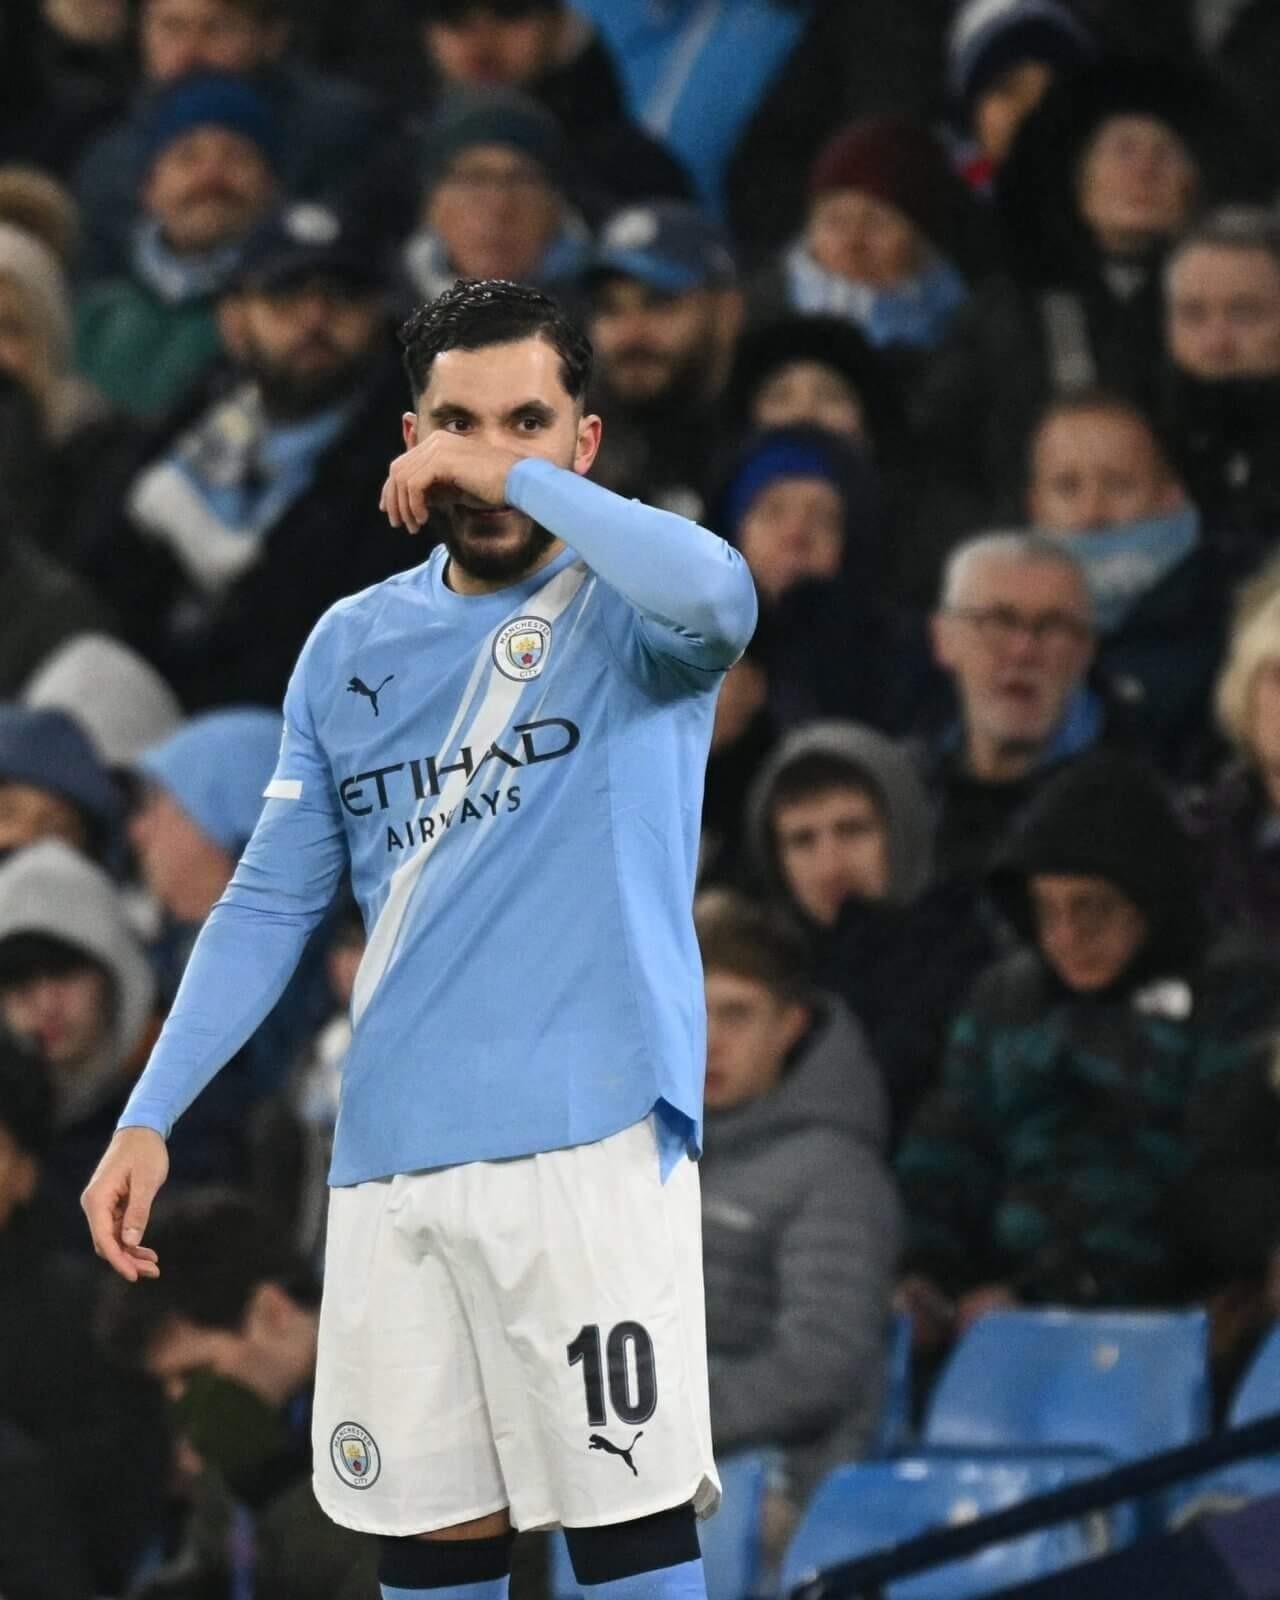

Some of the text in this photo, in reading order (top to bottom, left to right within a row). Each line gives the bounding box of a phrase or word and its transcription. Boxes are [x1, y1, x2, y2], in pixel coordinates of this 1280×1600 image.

[500, 621, 551, 645] MANCHESTER
[338, 717, 582, 818] ETIHAD
[566, 1319, 659, 1428] 10
